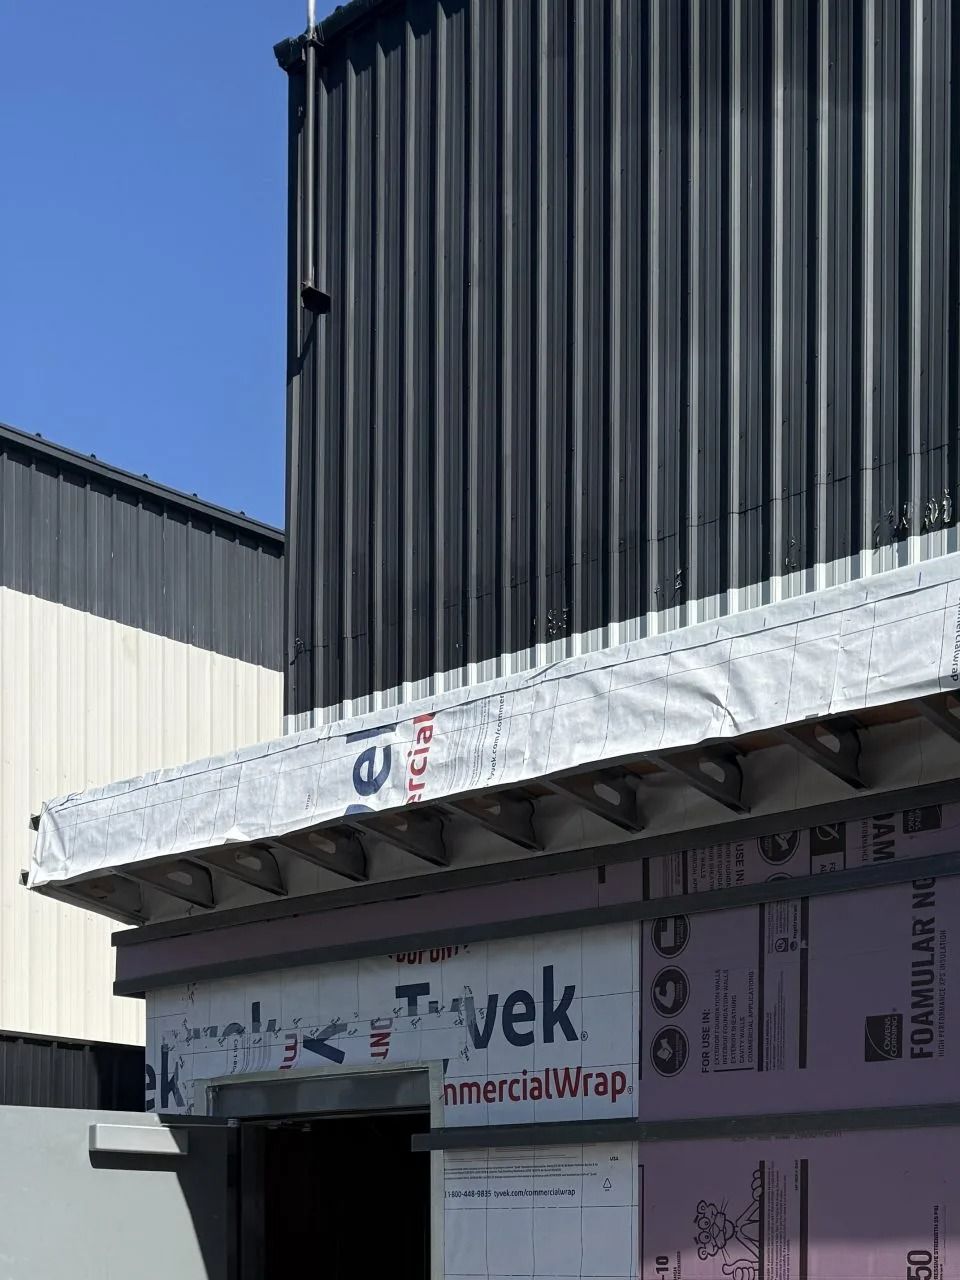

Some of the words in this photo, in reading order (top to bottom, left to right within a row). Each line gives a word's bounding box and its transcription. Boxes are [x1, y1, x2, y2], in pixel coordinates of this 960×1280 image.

[701, 1026, 711, 1049] USE
[883, 1016, 891, 1050] OWENS
[701, 1051, 711, 1073] FOR
